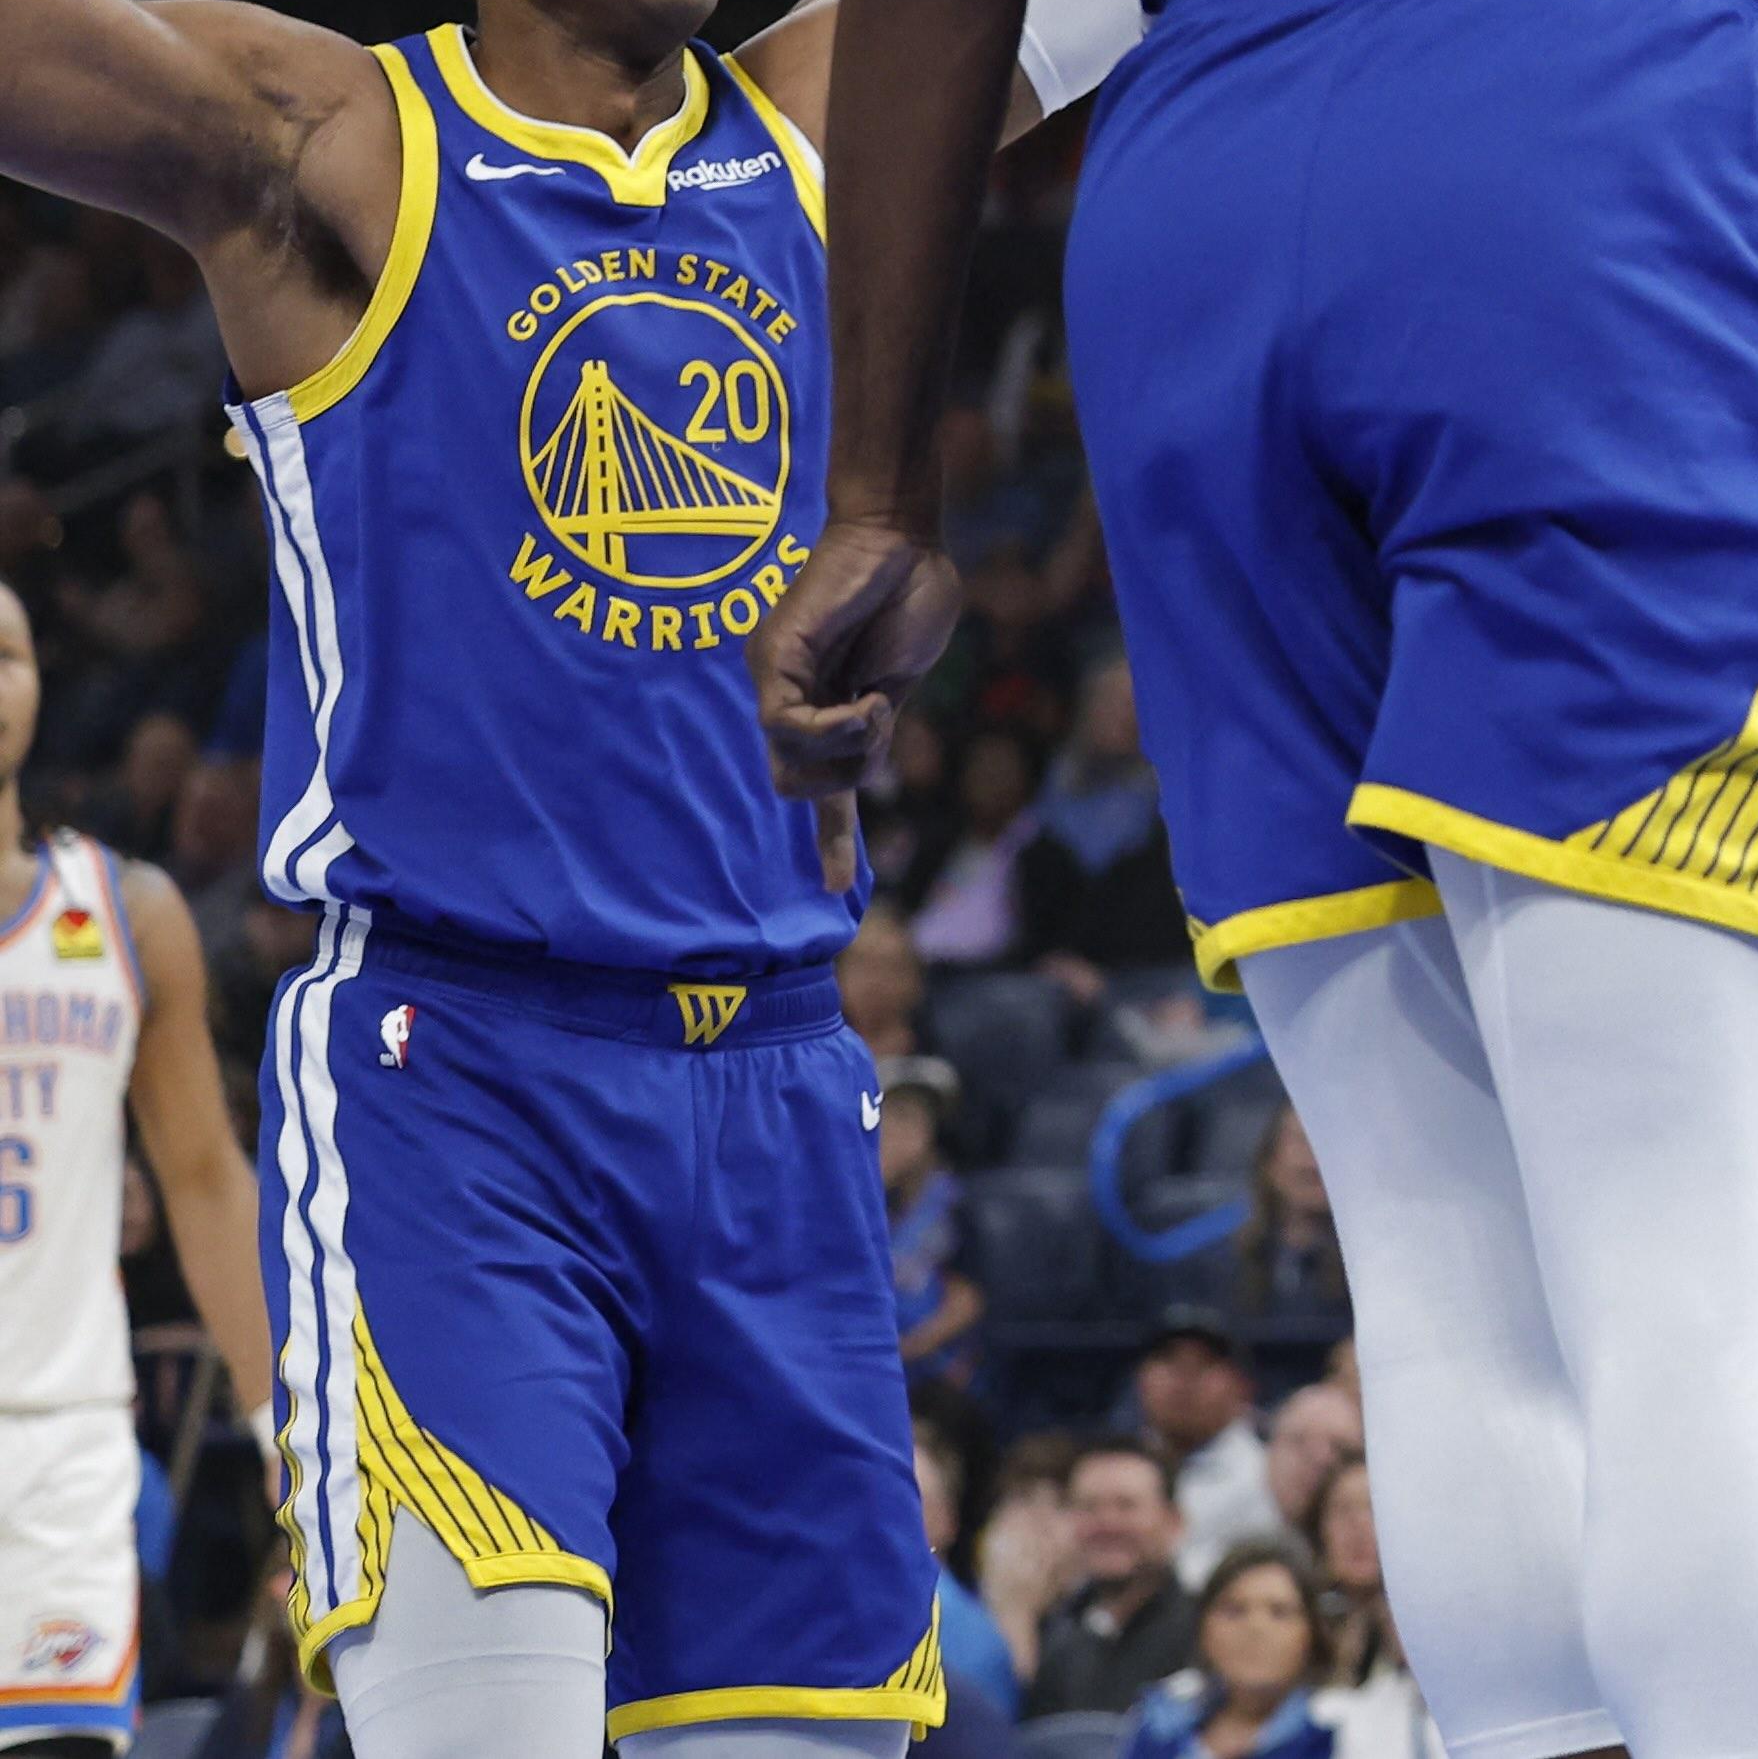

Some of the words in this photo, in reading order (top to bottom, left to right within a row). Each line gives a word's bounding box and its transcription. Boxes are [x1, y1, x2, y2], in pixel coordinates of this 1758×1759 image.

[667, 151, 781, 192] Rakuten
[507, 248, 656, 342] GOLDEN
[676, 254, 798, 345] STATE
[679, 359, 771, 444] 20
[508, 533, 812, 651] WARRIORS
